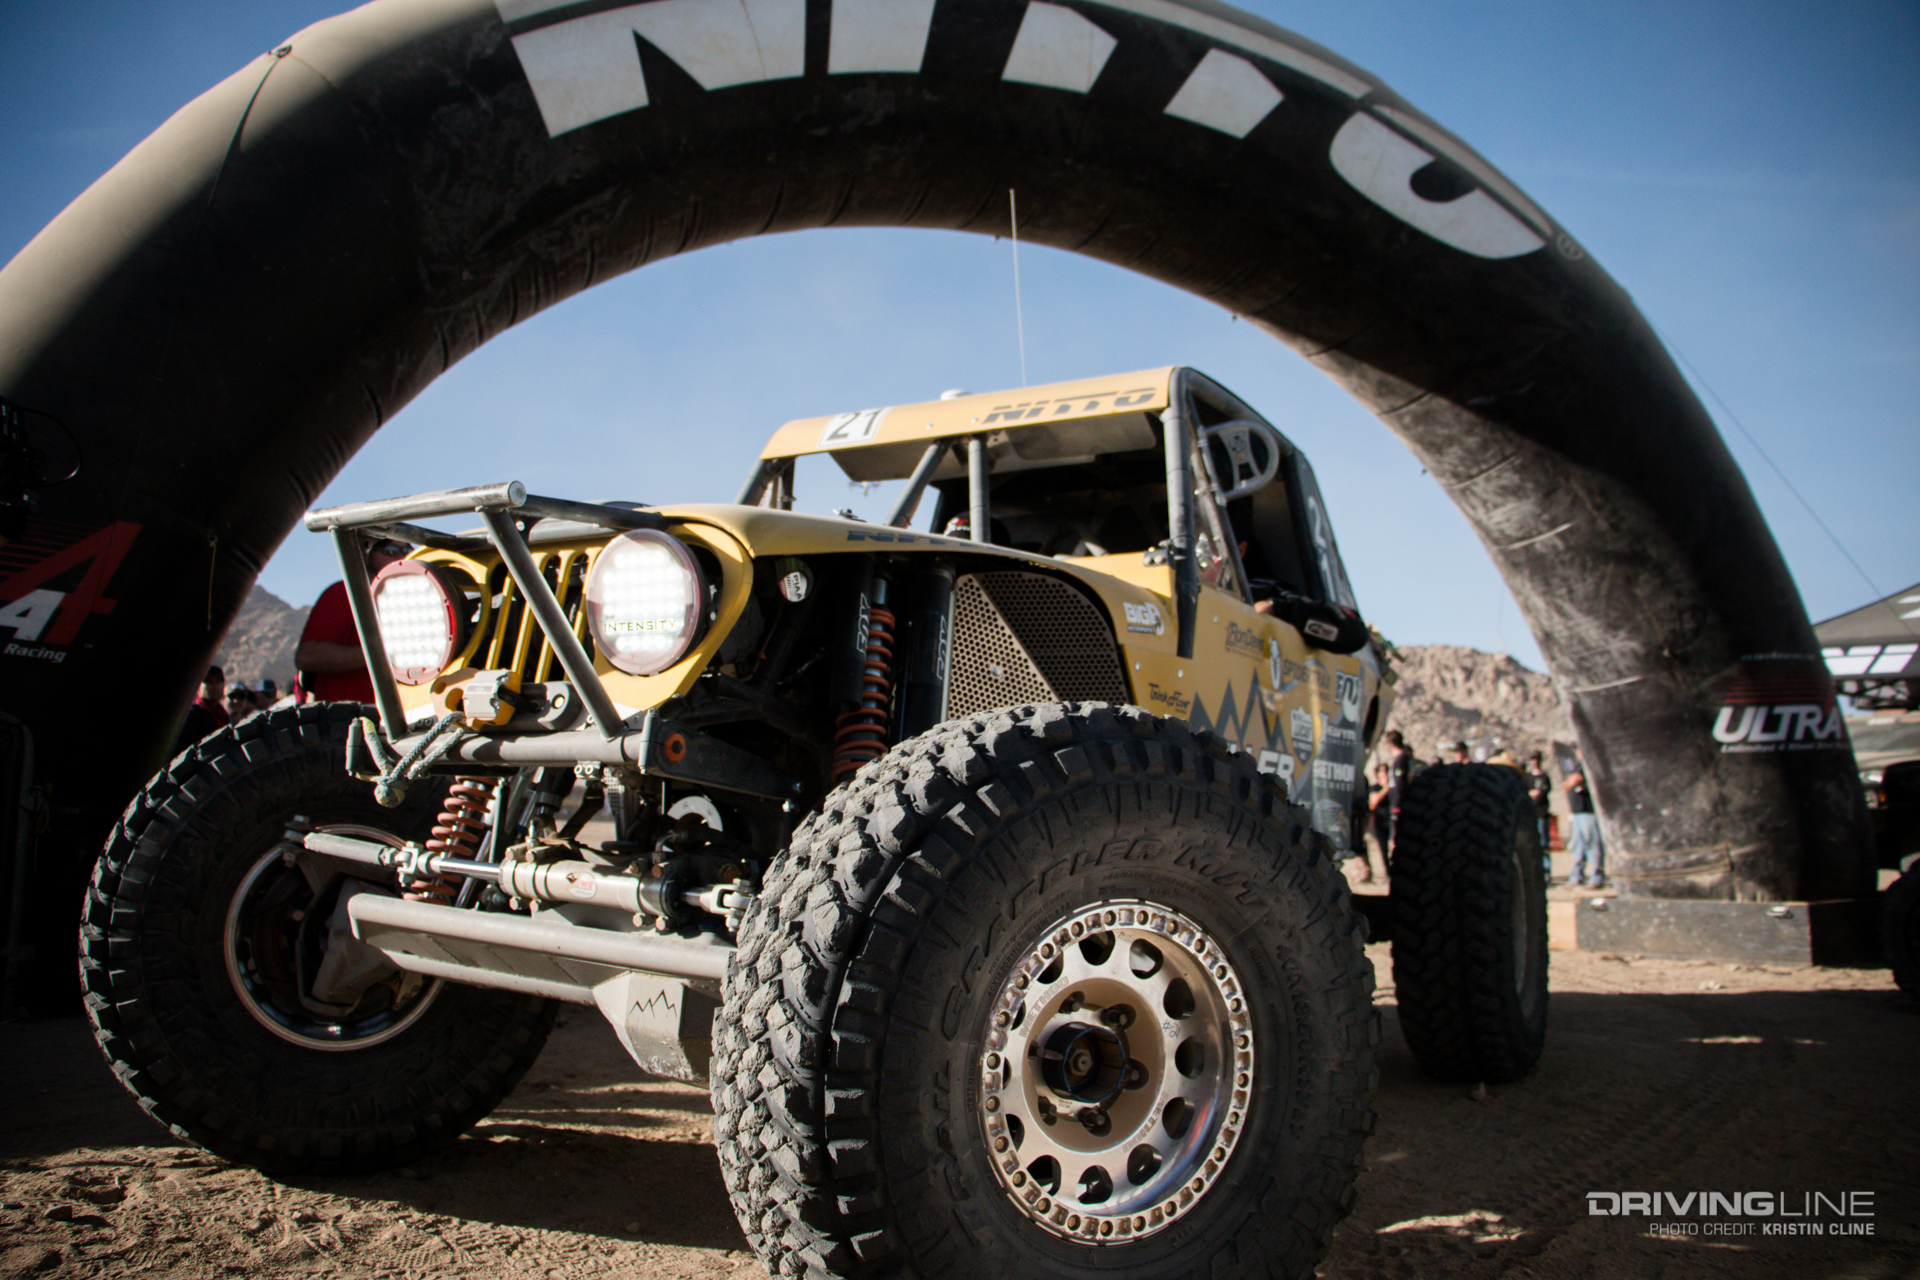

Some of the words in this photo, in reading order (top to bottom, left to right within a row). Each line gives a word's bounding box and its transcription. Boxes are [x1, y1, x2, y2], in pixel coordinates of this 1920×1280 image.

[495, 0, 1553, 259] NITTO
[982, 387, 1157, 424] NITTO
[826, 409, 883, 441] 21
[604, 619, 677, 632] INTENSITY
[3, 643, 67, 663] Racing
[1712, 705, 1847, 743] ULTRA
[1019, 976, 1069, 1038] METHOD
